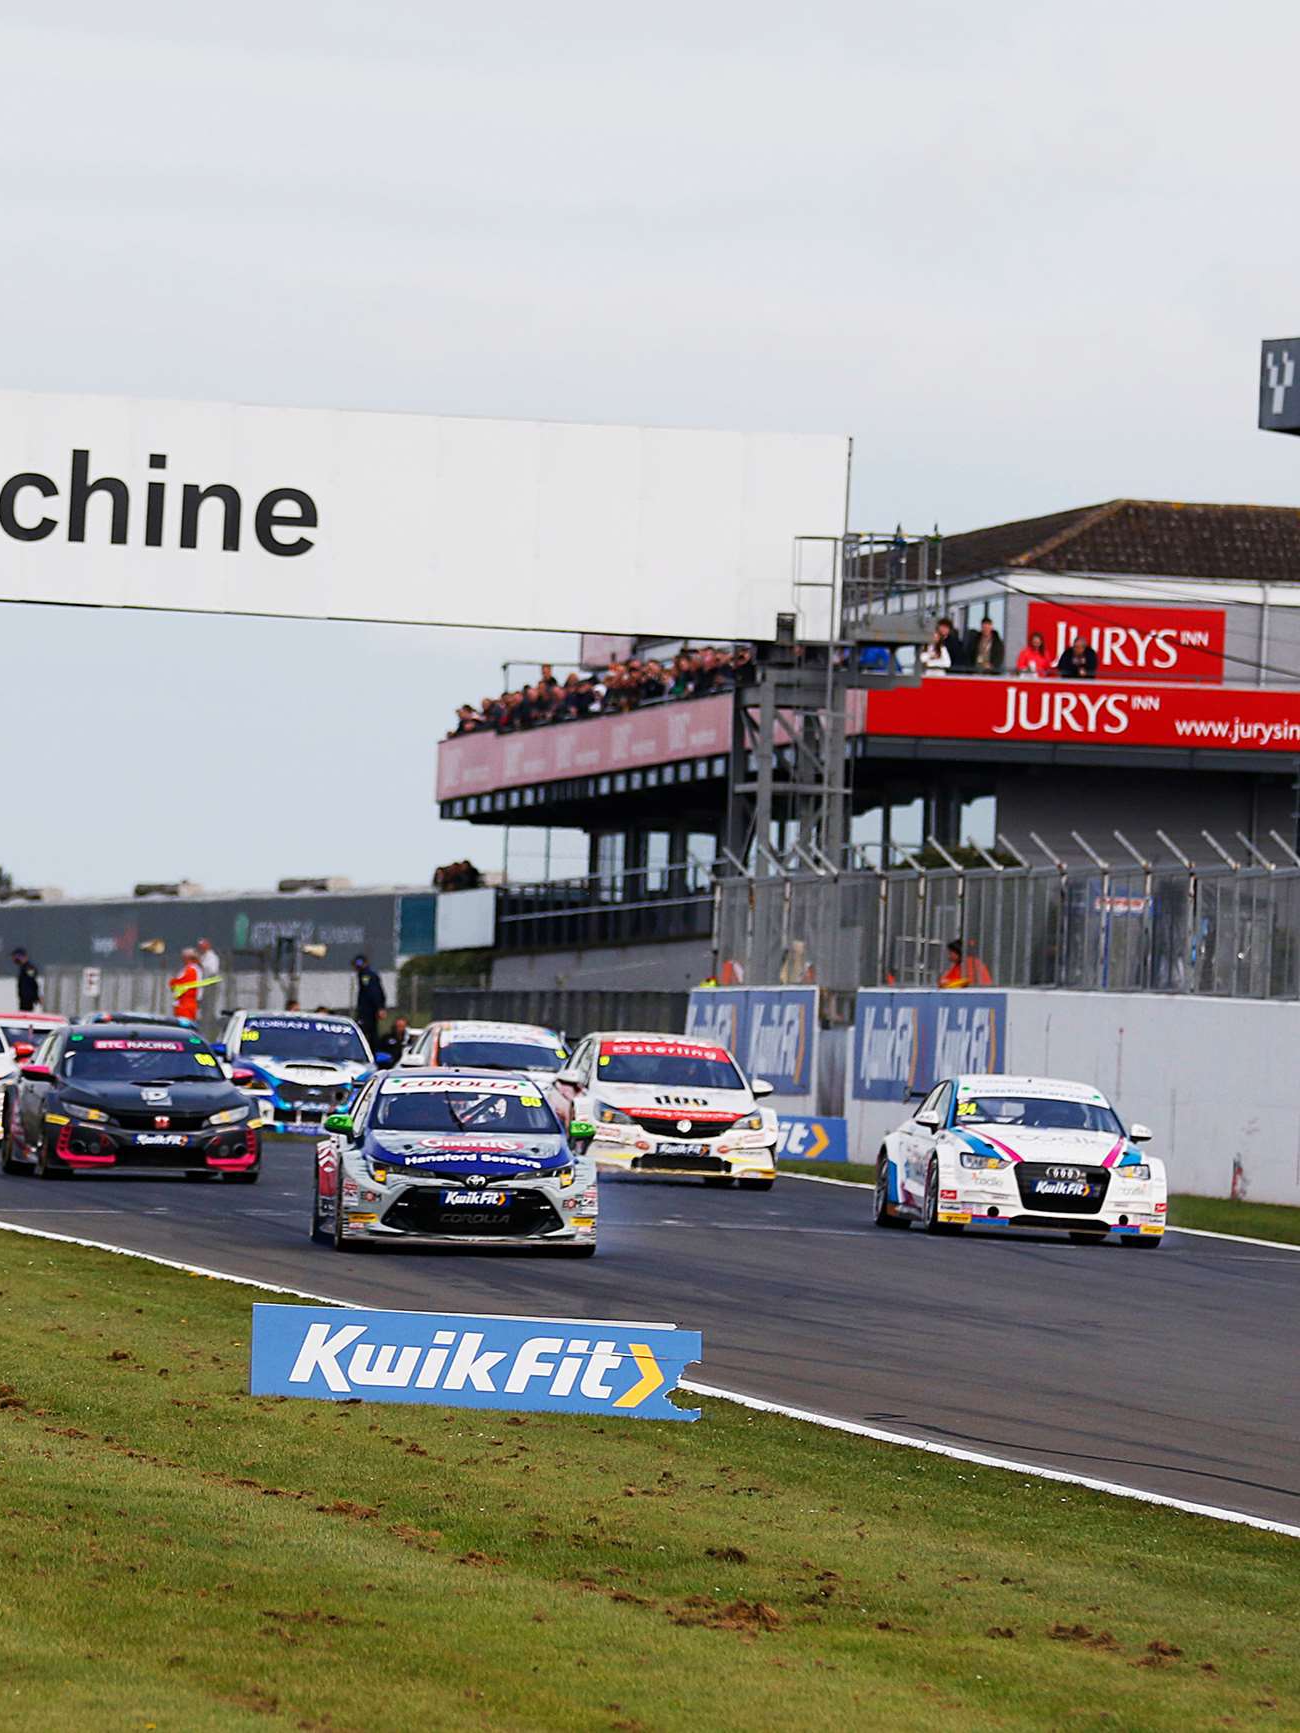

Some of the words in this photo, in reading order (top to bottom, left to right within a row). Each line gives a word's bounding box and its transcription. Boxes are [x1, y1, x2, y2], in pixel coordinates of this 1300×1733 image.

[1180, 630, 1209, 647] INN
[992, 686, 1129, 734] JURYS
[1131, 694, 1161, 711] INN
[400, 1079, 519, 1091] COROLLA
[404, 1153, 477, 1168] Hansford
[480, 1153, 541, 1169] Sensors
[439, 1213, 511, 1224] COROLLA
